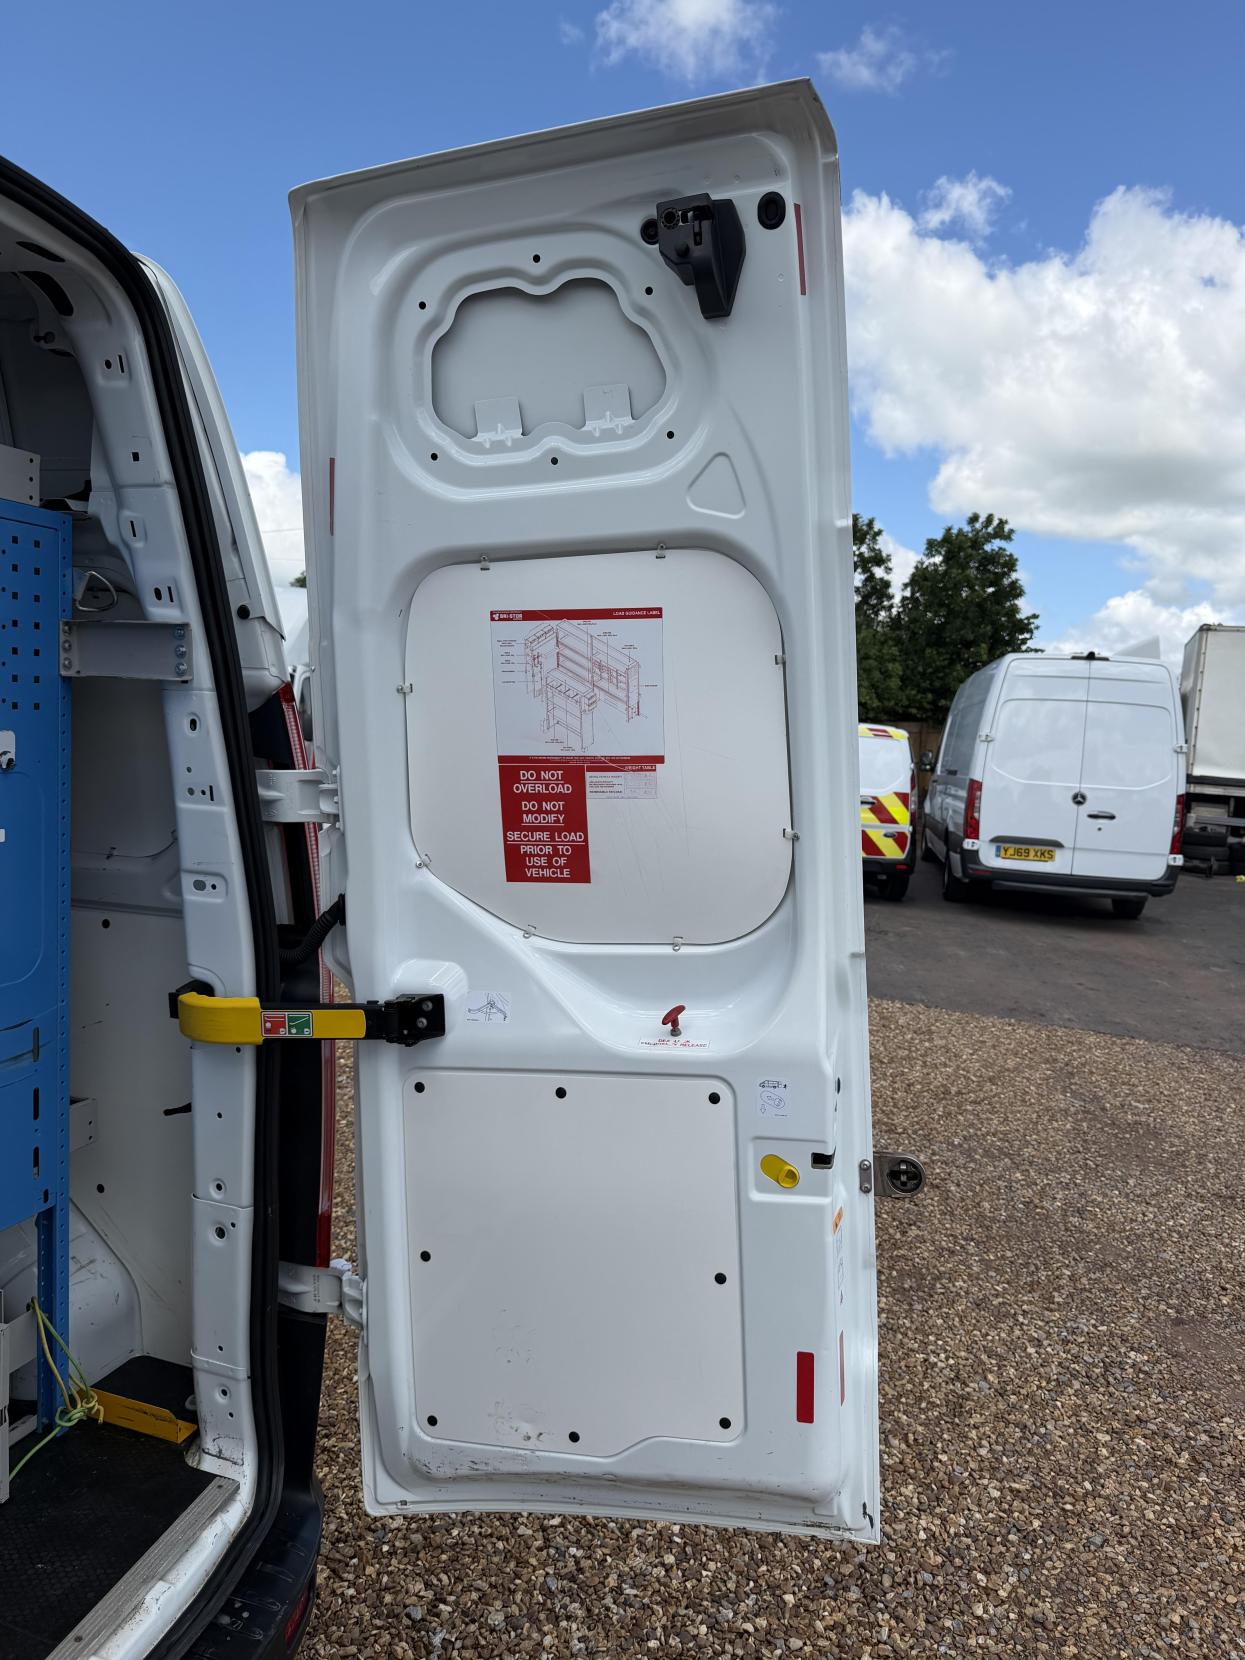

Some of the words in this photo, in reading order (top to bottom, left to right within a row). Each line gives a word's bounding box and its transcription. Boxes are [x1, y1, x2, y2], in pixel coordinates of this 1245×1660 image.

[520, 770, 536, 780] DO
[541, 770, 563, 780] NOT
[513, 784, 572, 793] OVERLOAD
[521, 801, 538, 811] DO
[542, 801, 565, 811] NOT
[522, 813, 565, 823] MODIFY
[506, 831, 551, 841] SECURE
[555, 832, 584, 841] LOAD
[520, 845, 553, 855] PRIOR
[557, 845, 572, 855] TO
[1002, 846, 1030, 858] YJ69
[1032, 848, 1054, 860] XKS
[525, 857, 548, 866] USE
[552, 857, 568, 866] OF
[525, 868, 571, 878] VEHICLE
